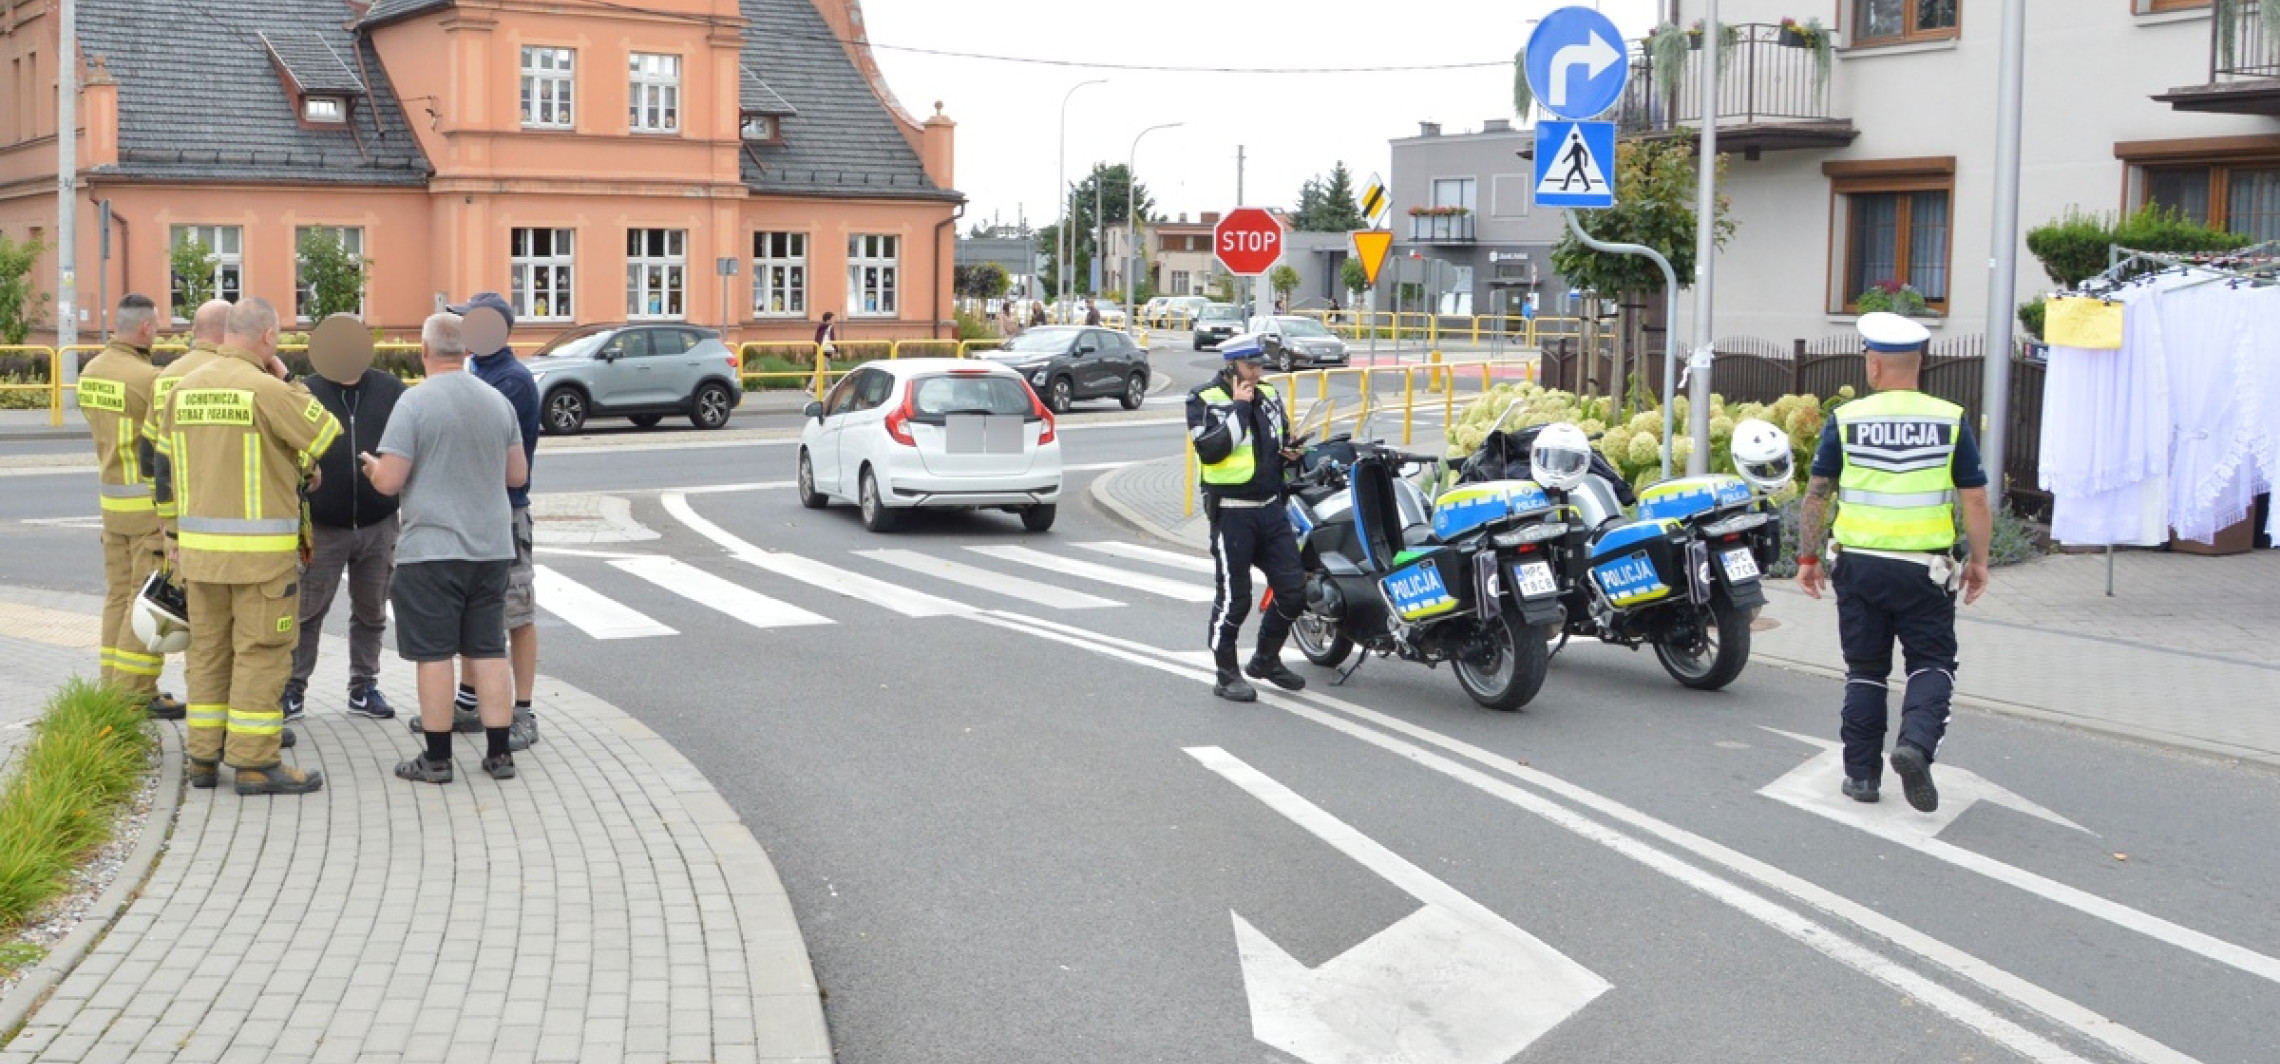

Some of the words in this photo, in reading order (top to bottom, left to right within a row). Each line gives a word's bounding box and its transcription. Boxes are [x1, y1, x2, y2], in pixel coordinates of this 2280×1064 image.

[1222, 231, 1276, 252] STOP
[1857, 423, 1939, 446] POLICJA
[1391, 569, 1441, 600] POLICJA
[1601, 560, 1654, 590] POLICJA
